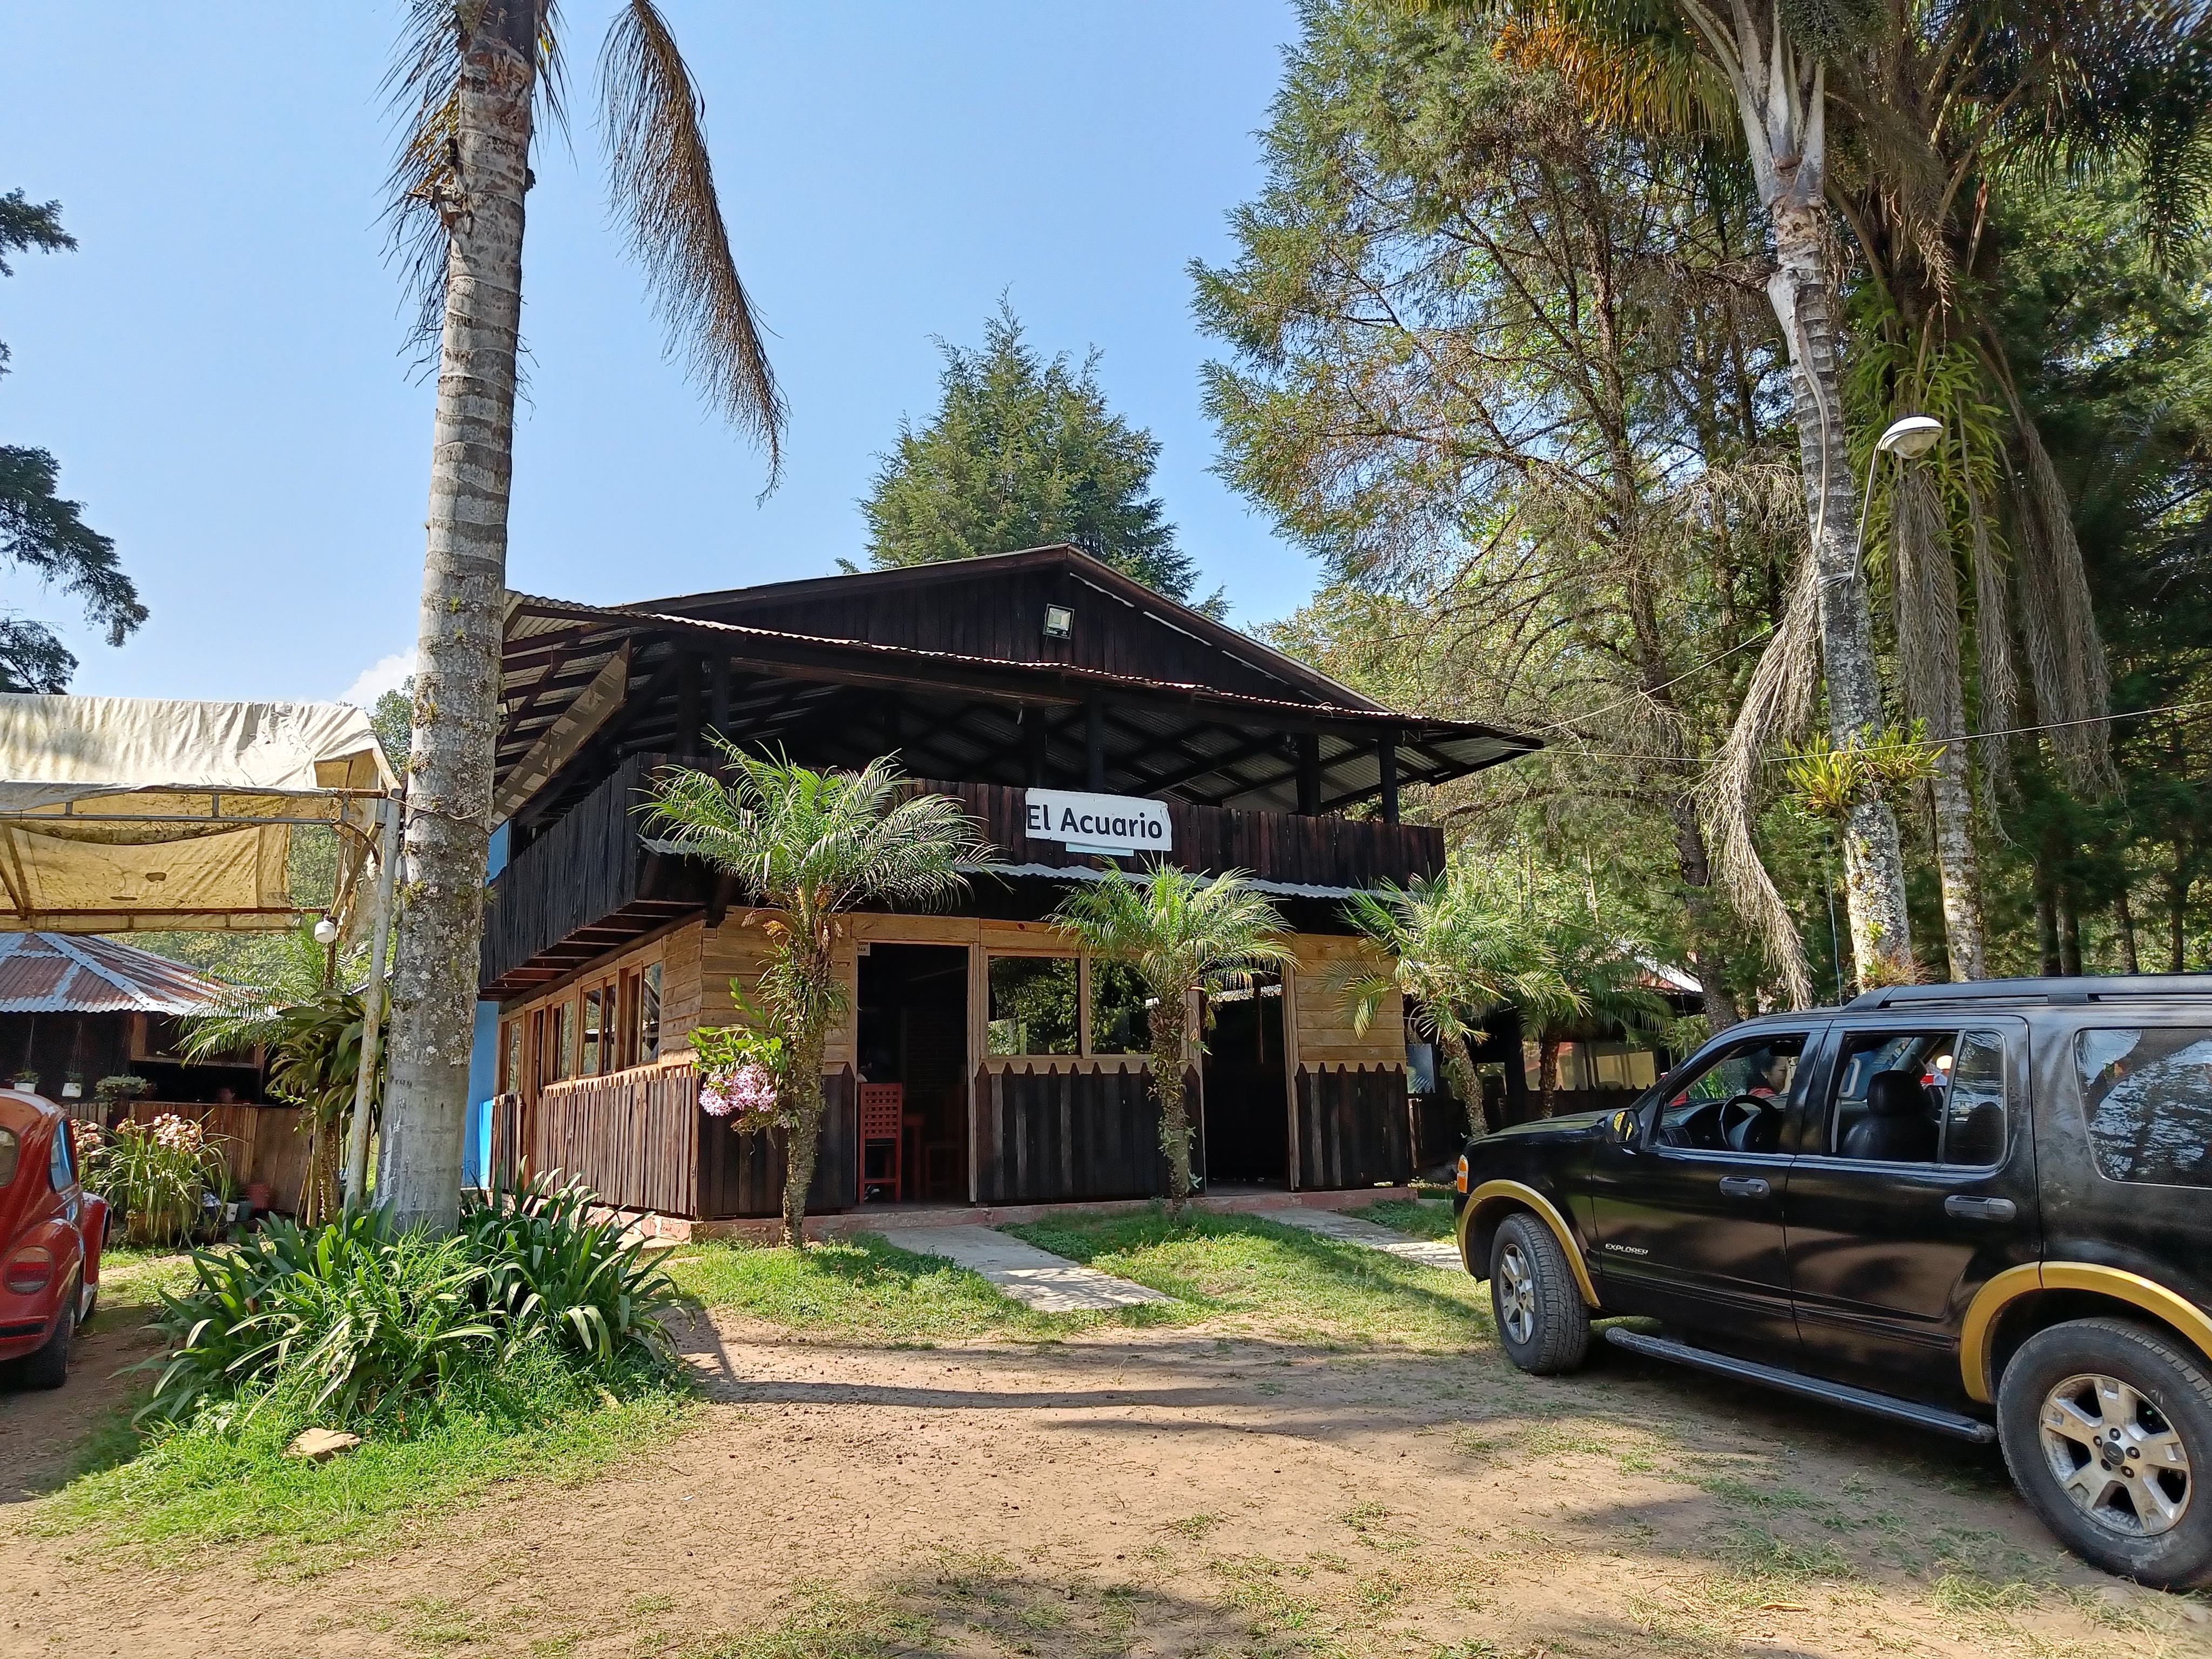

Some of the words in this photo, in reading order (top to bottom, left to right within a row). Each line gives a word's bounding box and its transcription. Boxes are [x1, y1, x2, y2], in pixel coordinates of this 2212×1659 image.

[1027, 804, 1051, 831] El
[1060, 807, 1162, 839] Acuario
[1605, 1243, 1649, 1256] EXPLORER
